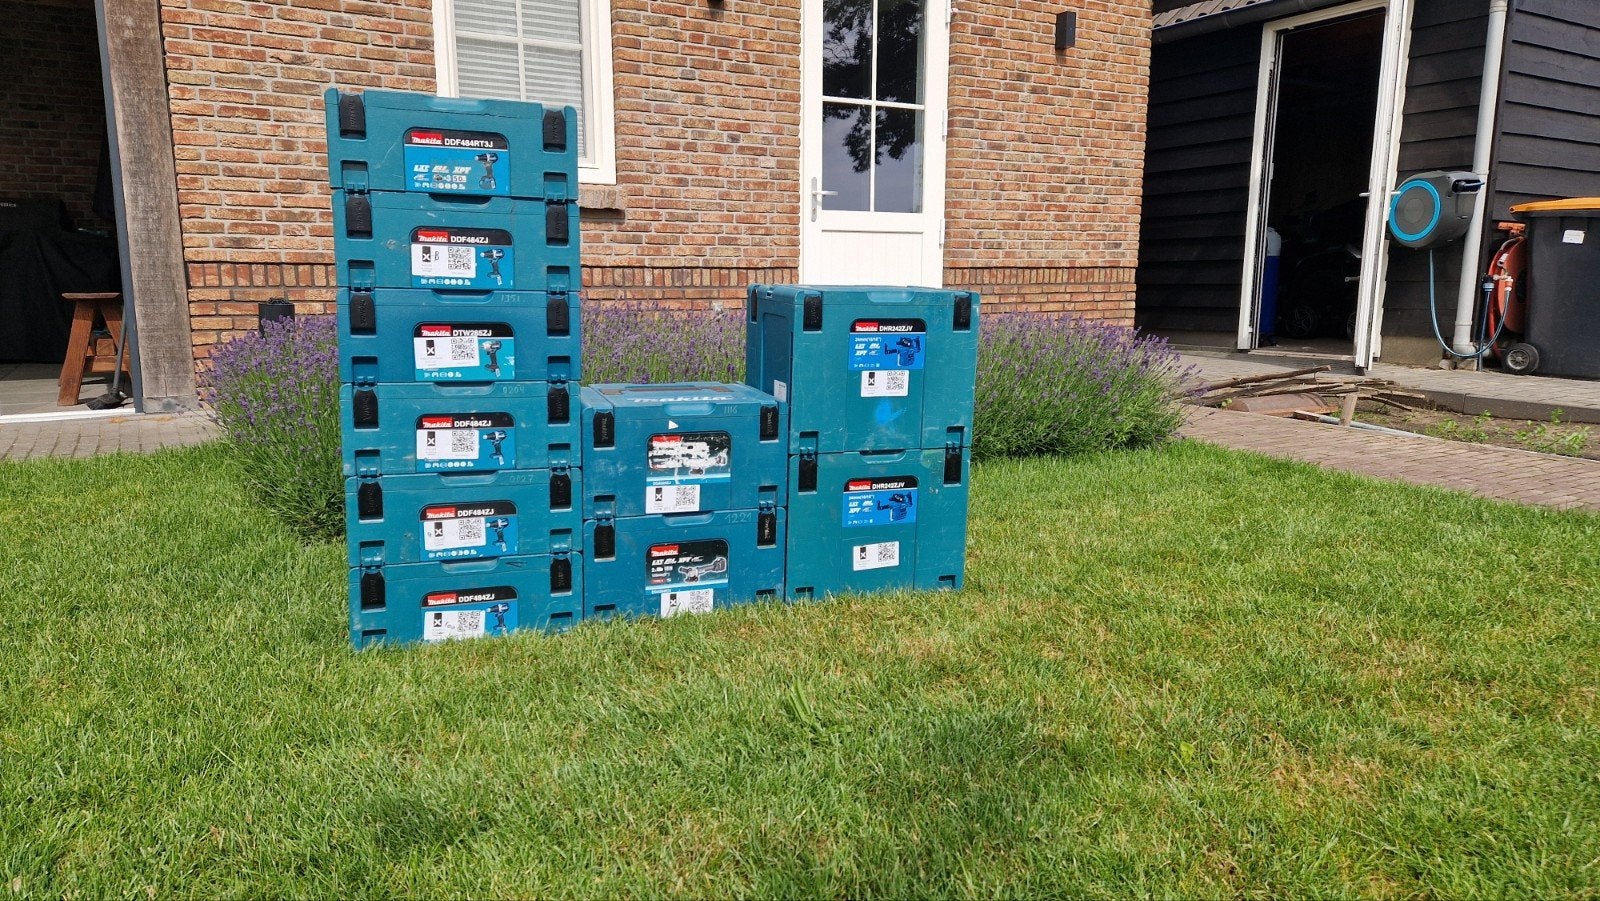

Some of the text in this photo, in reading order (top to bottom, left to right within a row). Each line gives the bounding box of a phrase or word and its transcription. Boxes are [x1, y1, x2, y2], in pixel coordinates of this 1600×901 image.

[444, 138, 493, 148] DDF484RT3J
[450, 235, 489, 244] DDF484ZJ
[452, 329, 492, 337] DTW285ZJ
[872, 482, 905, 490] DHR242ZJV
[457, 508, 494, 517] DDF484ZJ
[458, 593, 495, 603] DDF484ZJ
